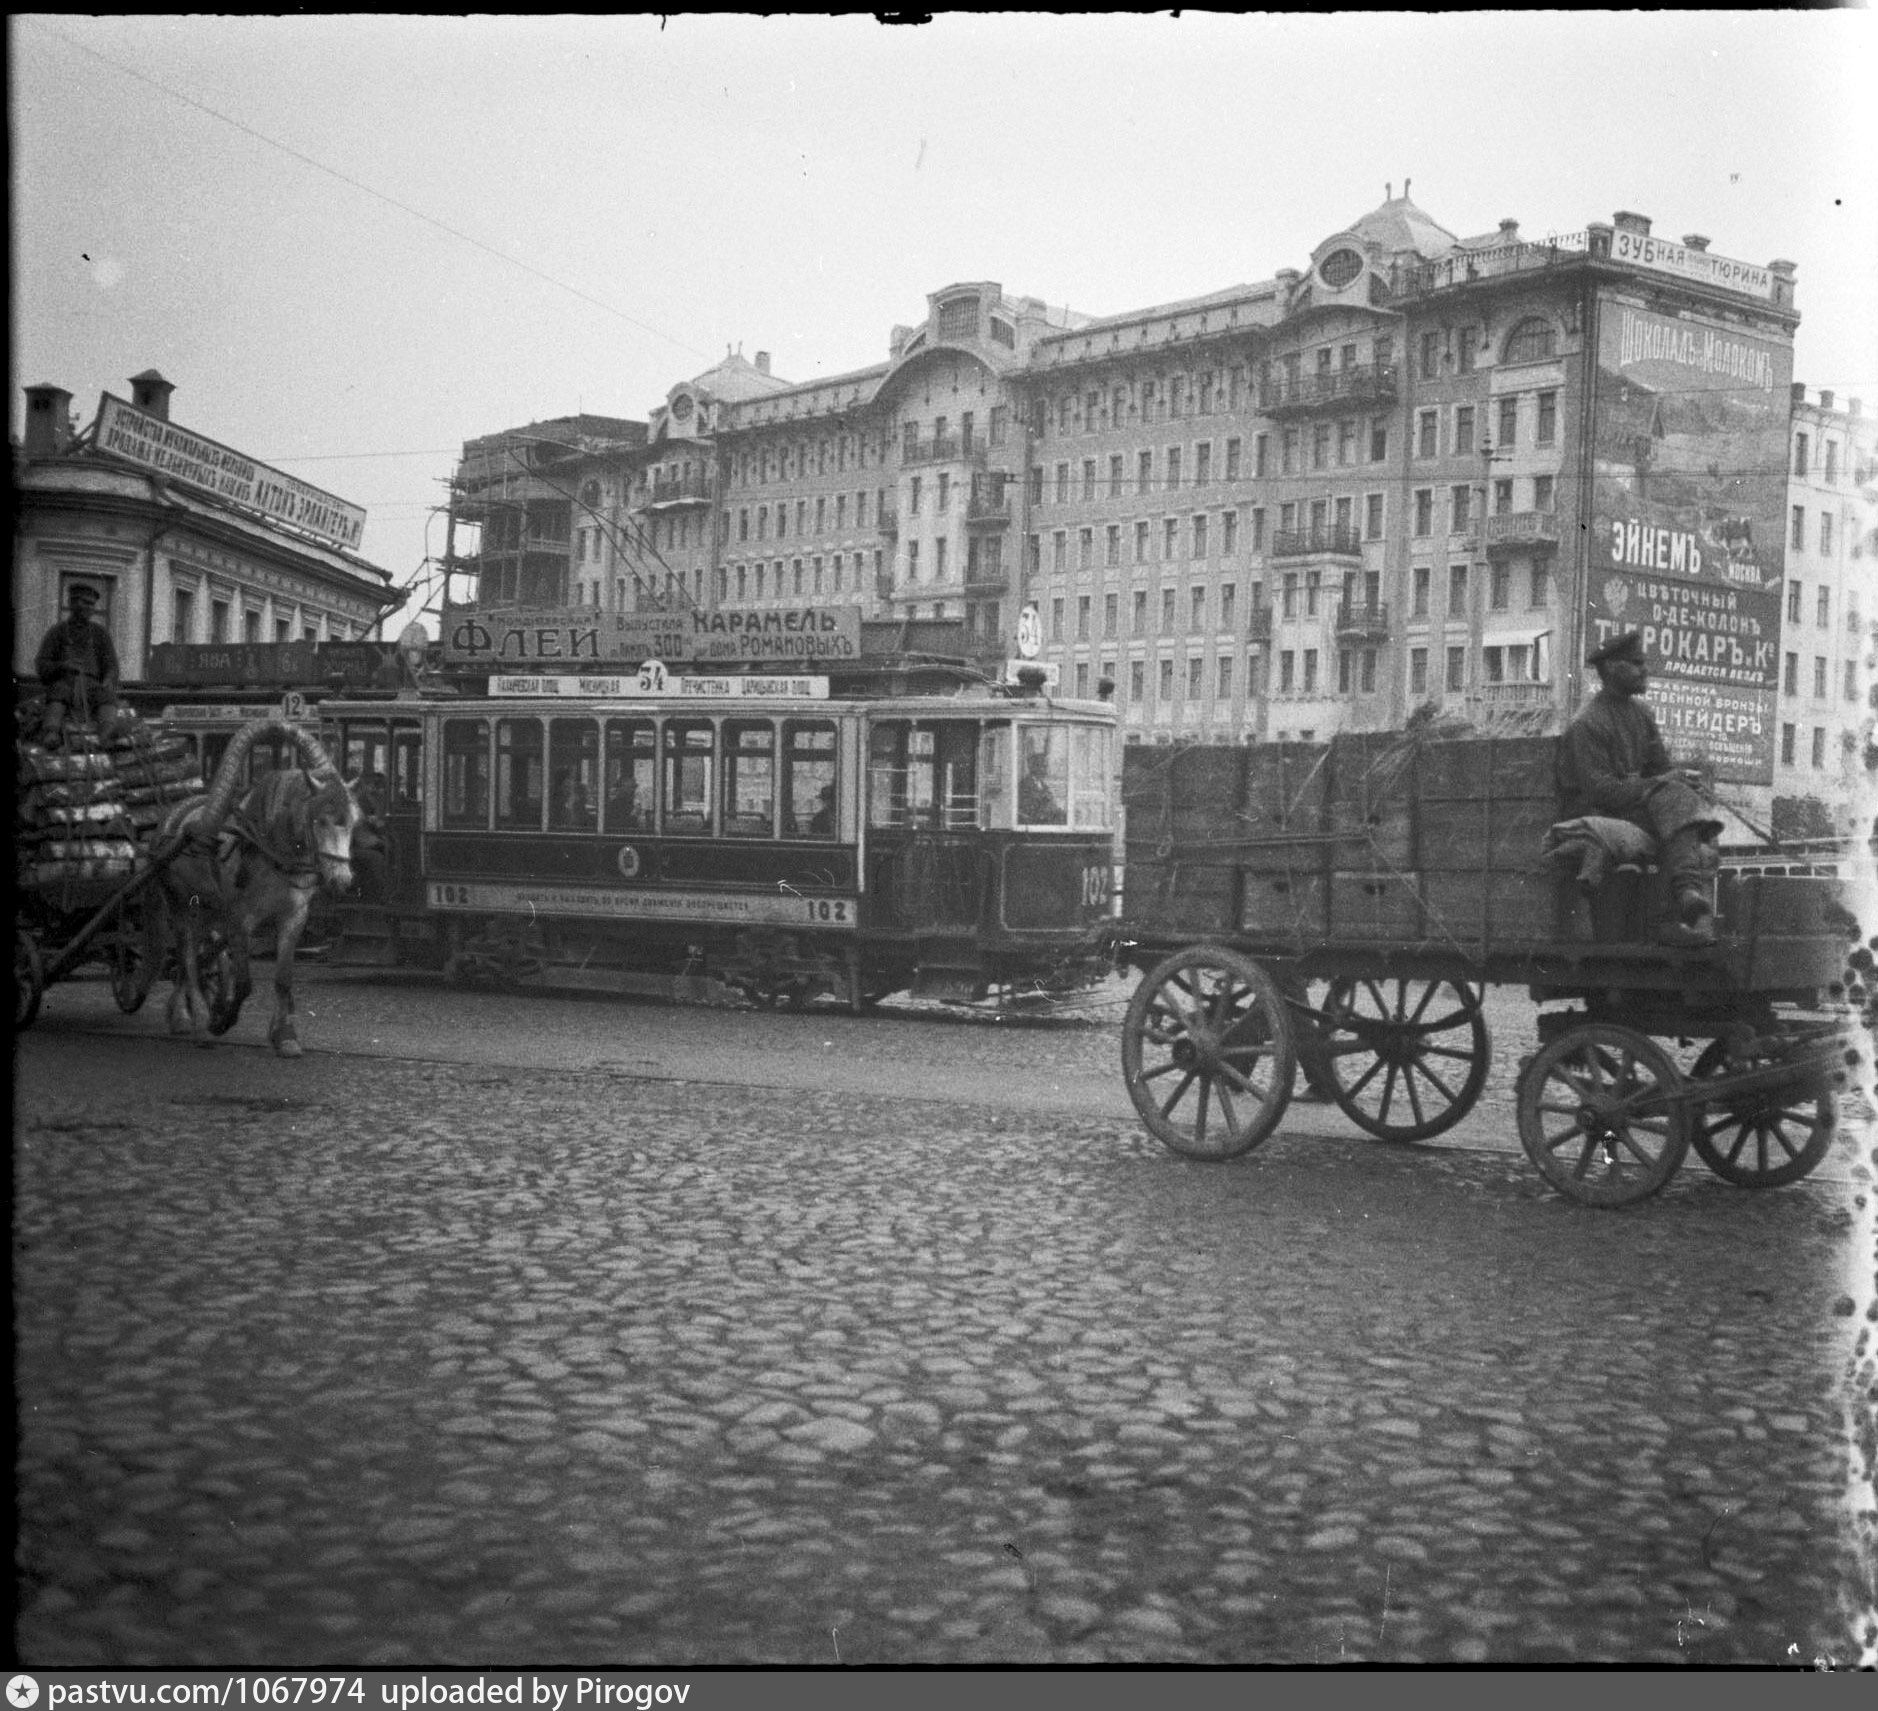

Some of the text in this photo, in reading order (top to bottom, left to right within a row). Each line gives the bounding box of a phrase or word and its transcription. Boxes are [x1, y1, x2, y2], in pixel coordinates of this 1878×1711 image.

[1619, 234, 1686, 265] ЗУБНАЯ
[1712, 259, 1768, 287] ТЮРИНА
[1612, 518, 1701, 574] ЭЙНЕМЪ
[1729, 562, 1761, 584] МОСКВА
[692, 609, 837, 634] КАРАМЕЛЬ
[654, 634, 682, 657] 300
[285, 695, 301, 716] 12
[436, 885, 469, 904] 102
[1081, 866, 1108, 906] 102
[808, 900, 847, 921] 102
